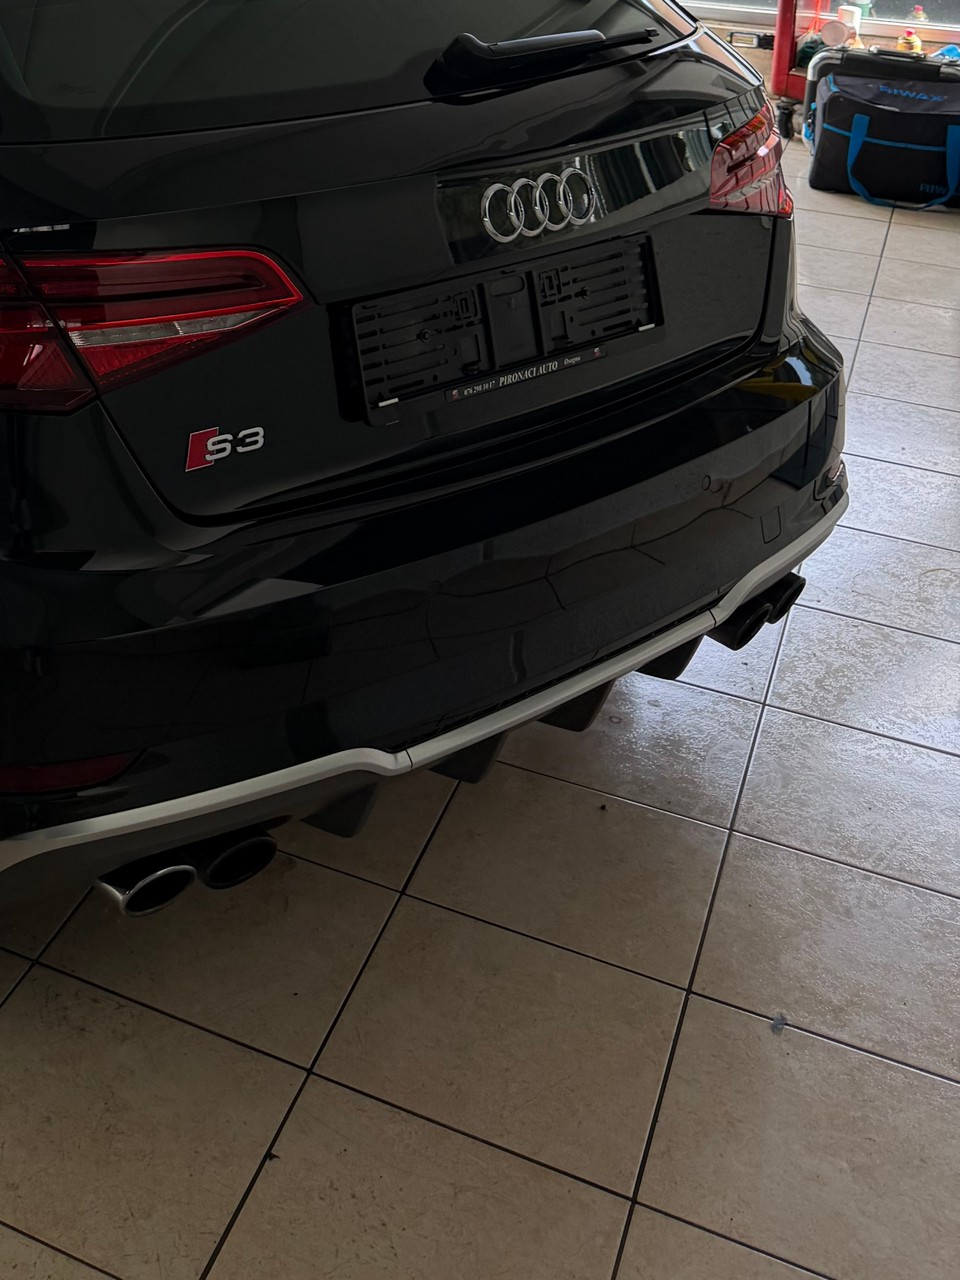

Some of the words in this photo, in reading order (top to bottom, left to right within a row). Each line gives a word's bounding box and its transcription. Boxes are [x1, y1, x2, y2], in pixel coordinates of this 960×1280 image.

[879, 84, 944, 103] RIWAX
[919, 183, 949, 195] RIW
[499, 367, 537, 387] PIRONACI
[538, 361, 558, 376] AUTO
[204, 426, 265, 461] S3
